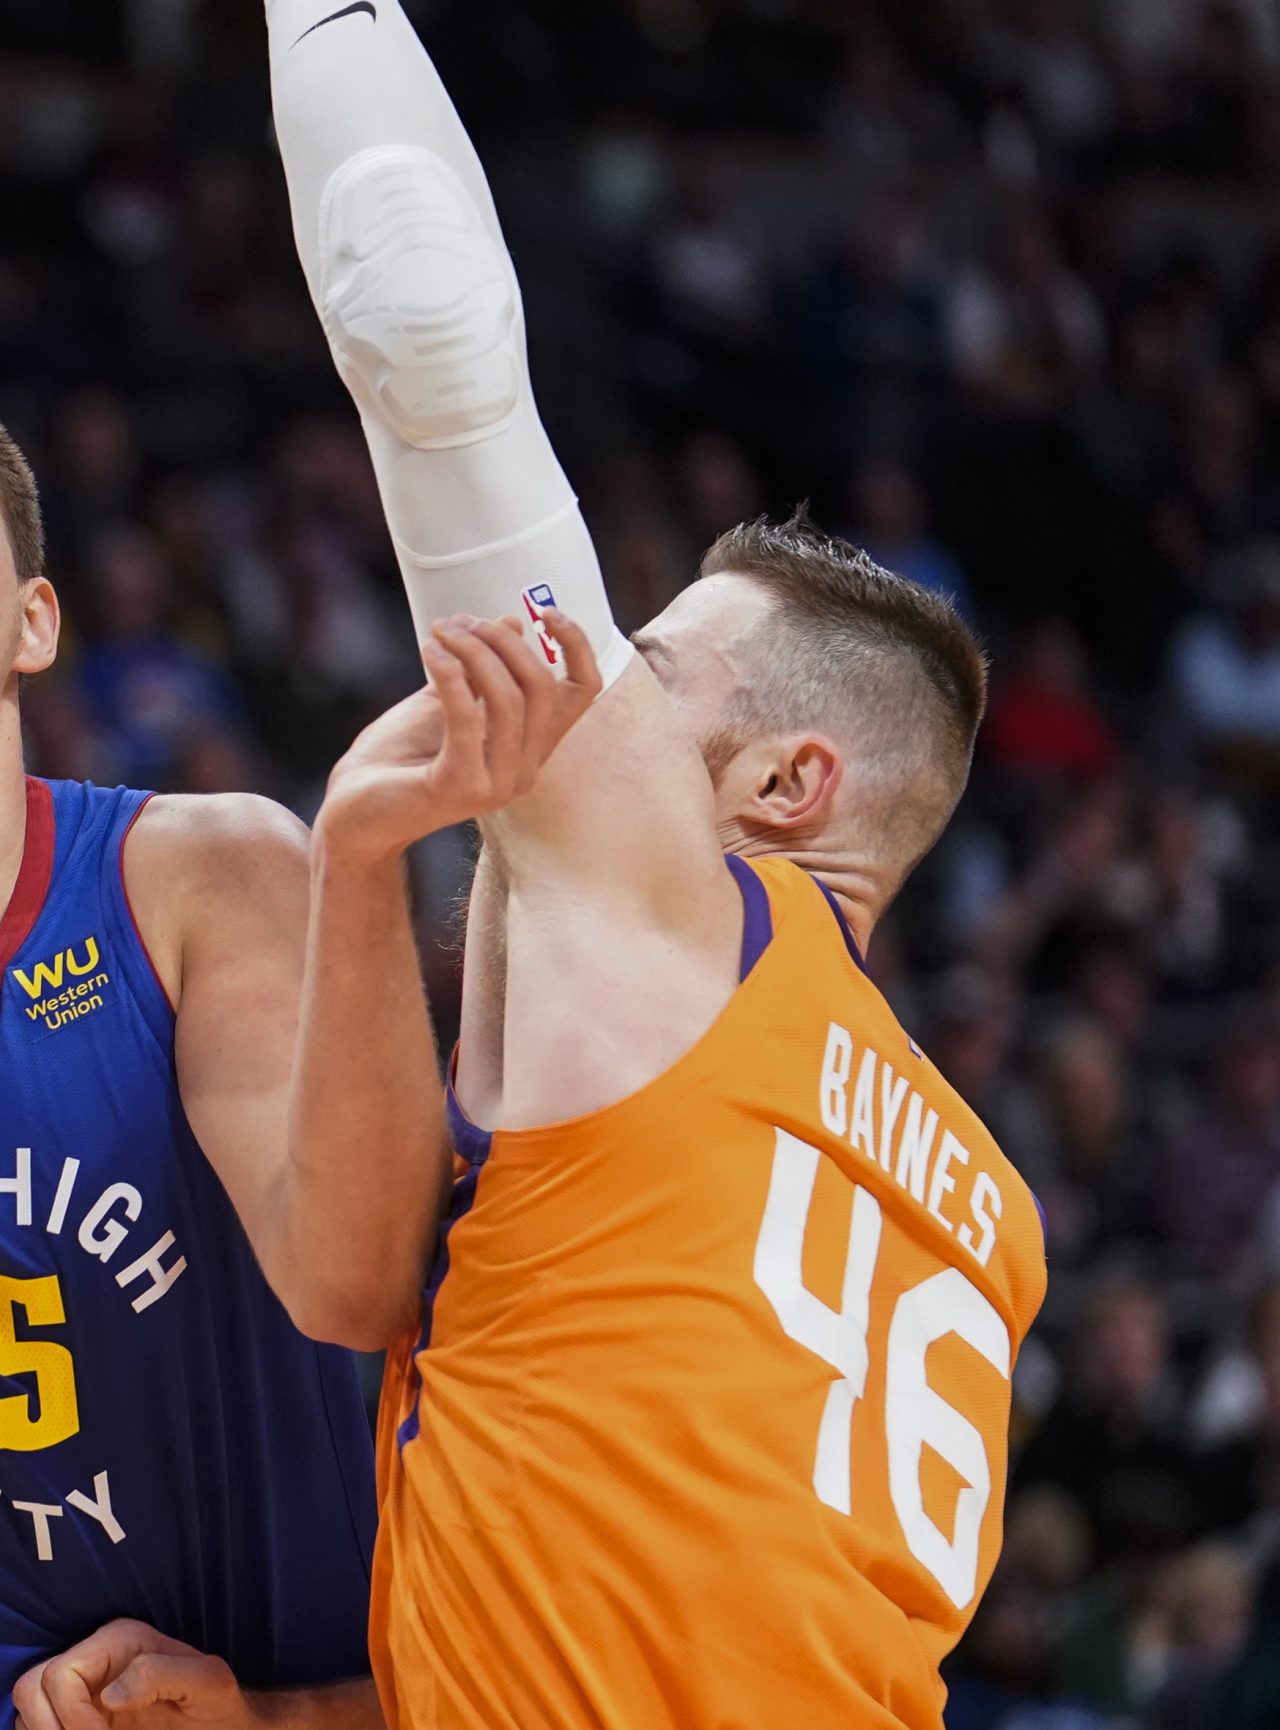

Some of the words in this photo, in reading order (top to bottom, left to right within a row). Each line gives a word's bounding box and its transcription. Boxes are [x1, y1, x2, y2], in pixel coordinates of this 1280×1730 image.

[13, 936, 99, 1000] WU
[25, 973, 109, 1021] Western
[45, 995, 103, 1030] Union
[821, 1022, 1002, 1267] BAYNES
[753, 1126, 1011, 1610] 46
